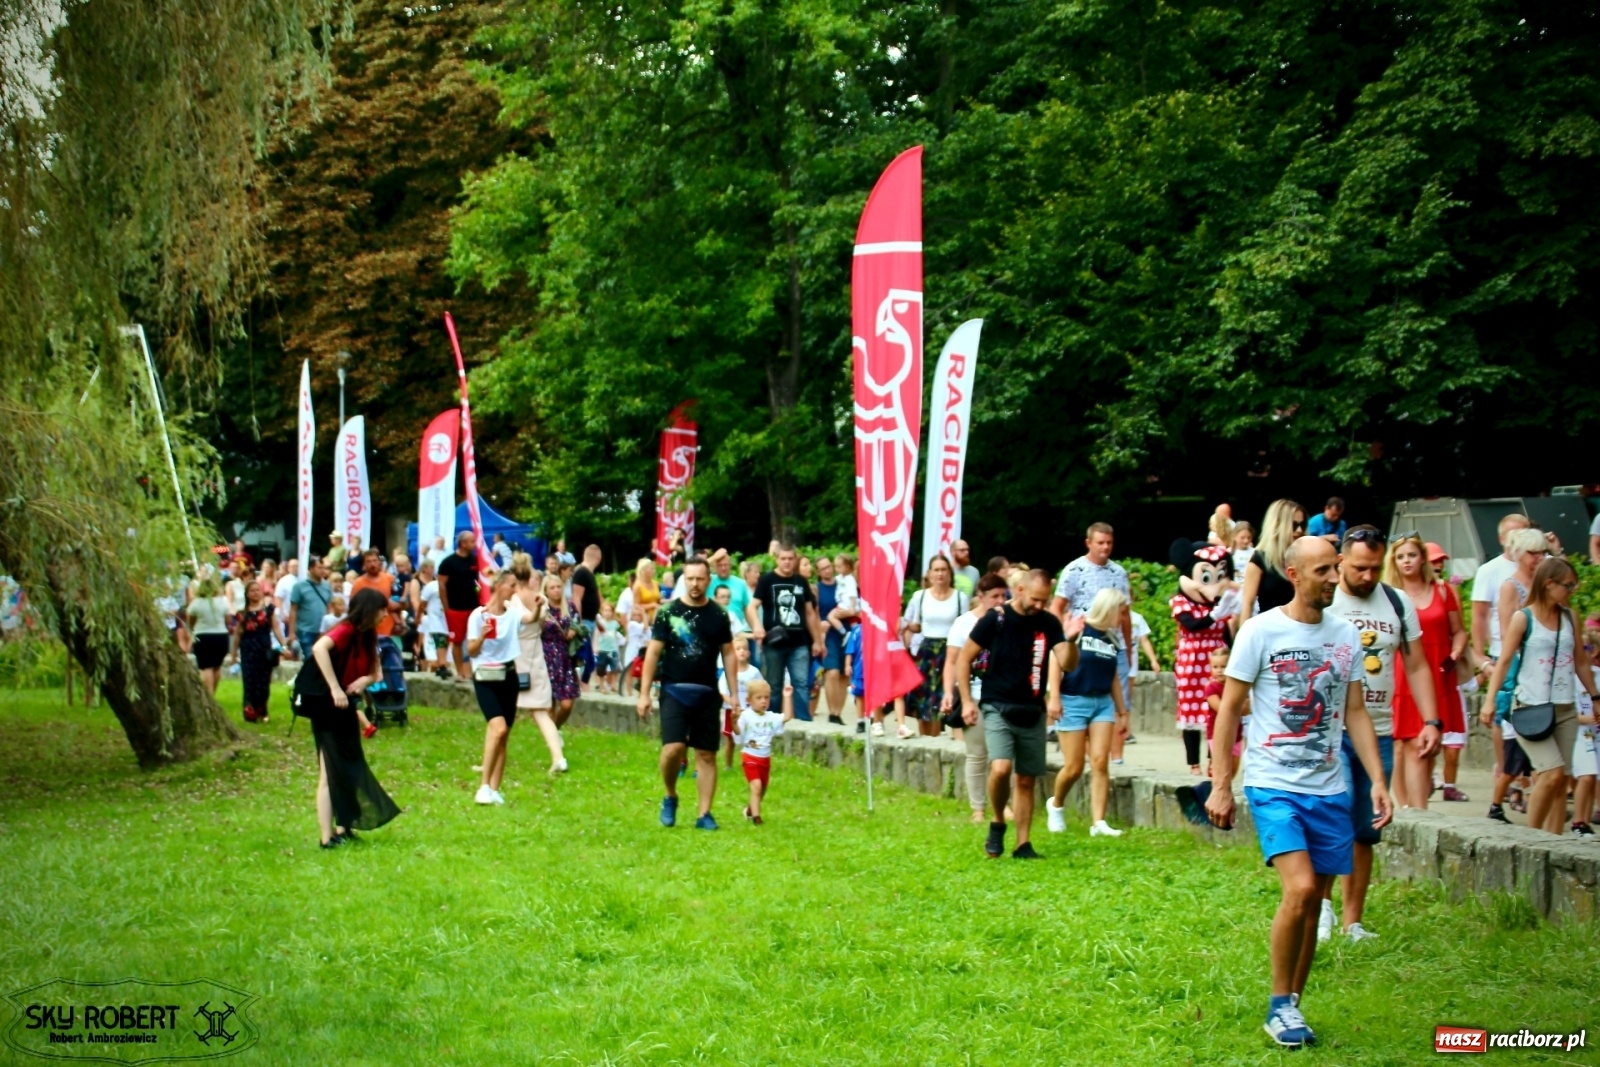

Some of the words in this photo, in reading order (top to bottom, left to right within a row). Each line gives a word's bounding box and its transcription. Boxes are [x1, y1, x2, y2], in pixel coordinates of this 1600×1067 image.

[1348, 618, 1394, 635] ONES
[1033, 640, 1045, 665] MAGA
[1294, 651, 1309, 661] No
[1031, 666, 1041, 690] KRAV
[1362, 690, 1388, 703] EZE
